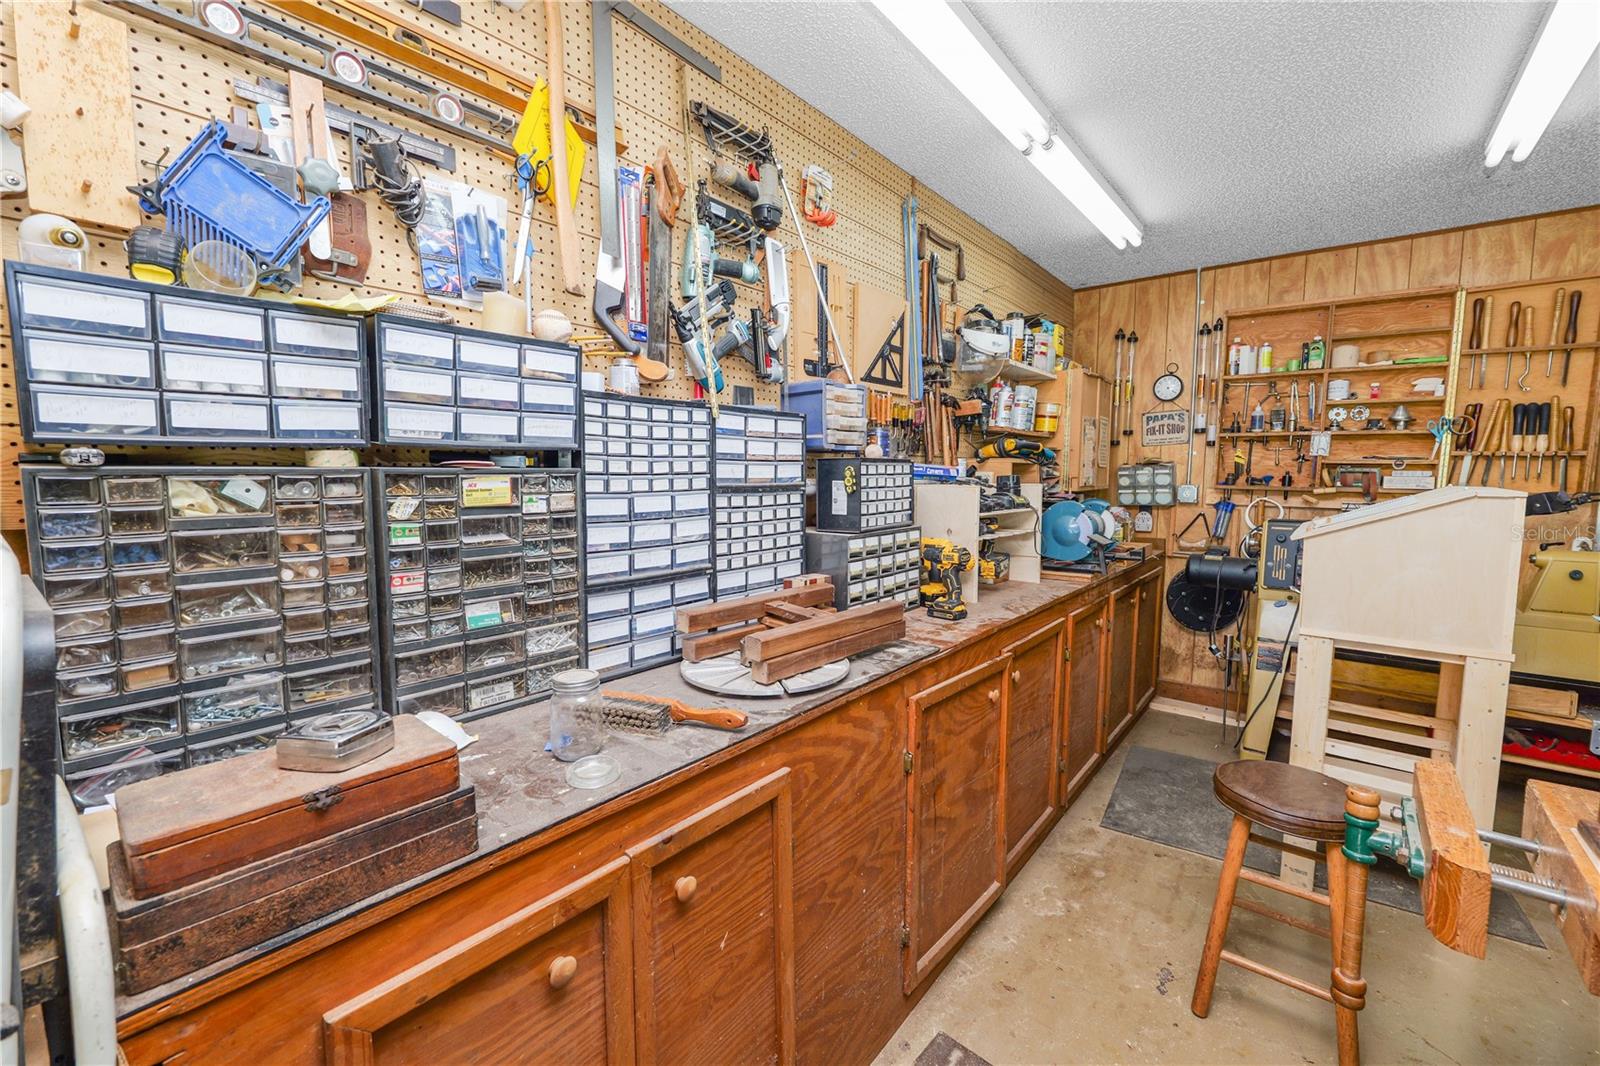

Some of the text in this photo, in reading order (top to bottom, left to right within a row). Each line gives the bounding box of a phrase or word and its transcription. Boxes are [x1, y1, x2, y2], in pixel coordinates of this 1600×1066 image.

[1146, 412, 1185, 426] PAPA'S
[1146, 423, 1185, 437] FIX-IT SHOP
